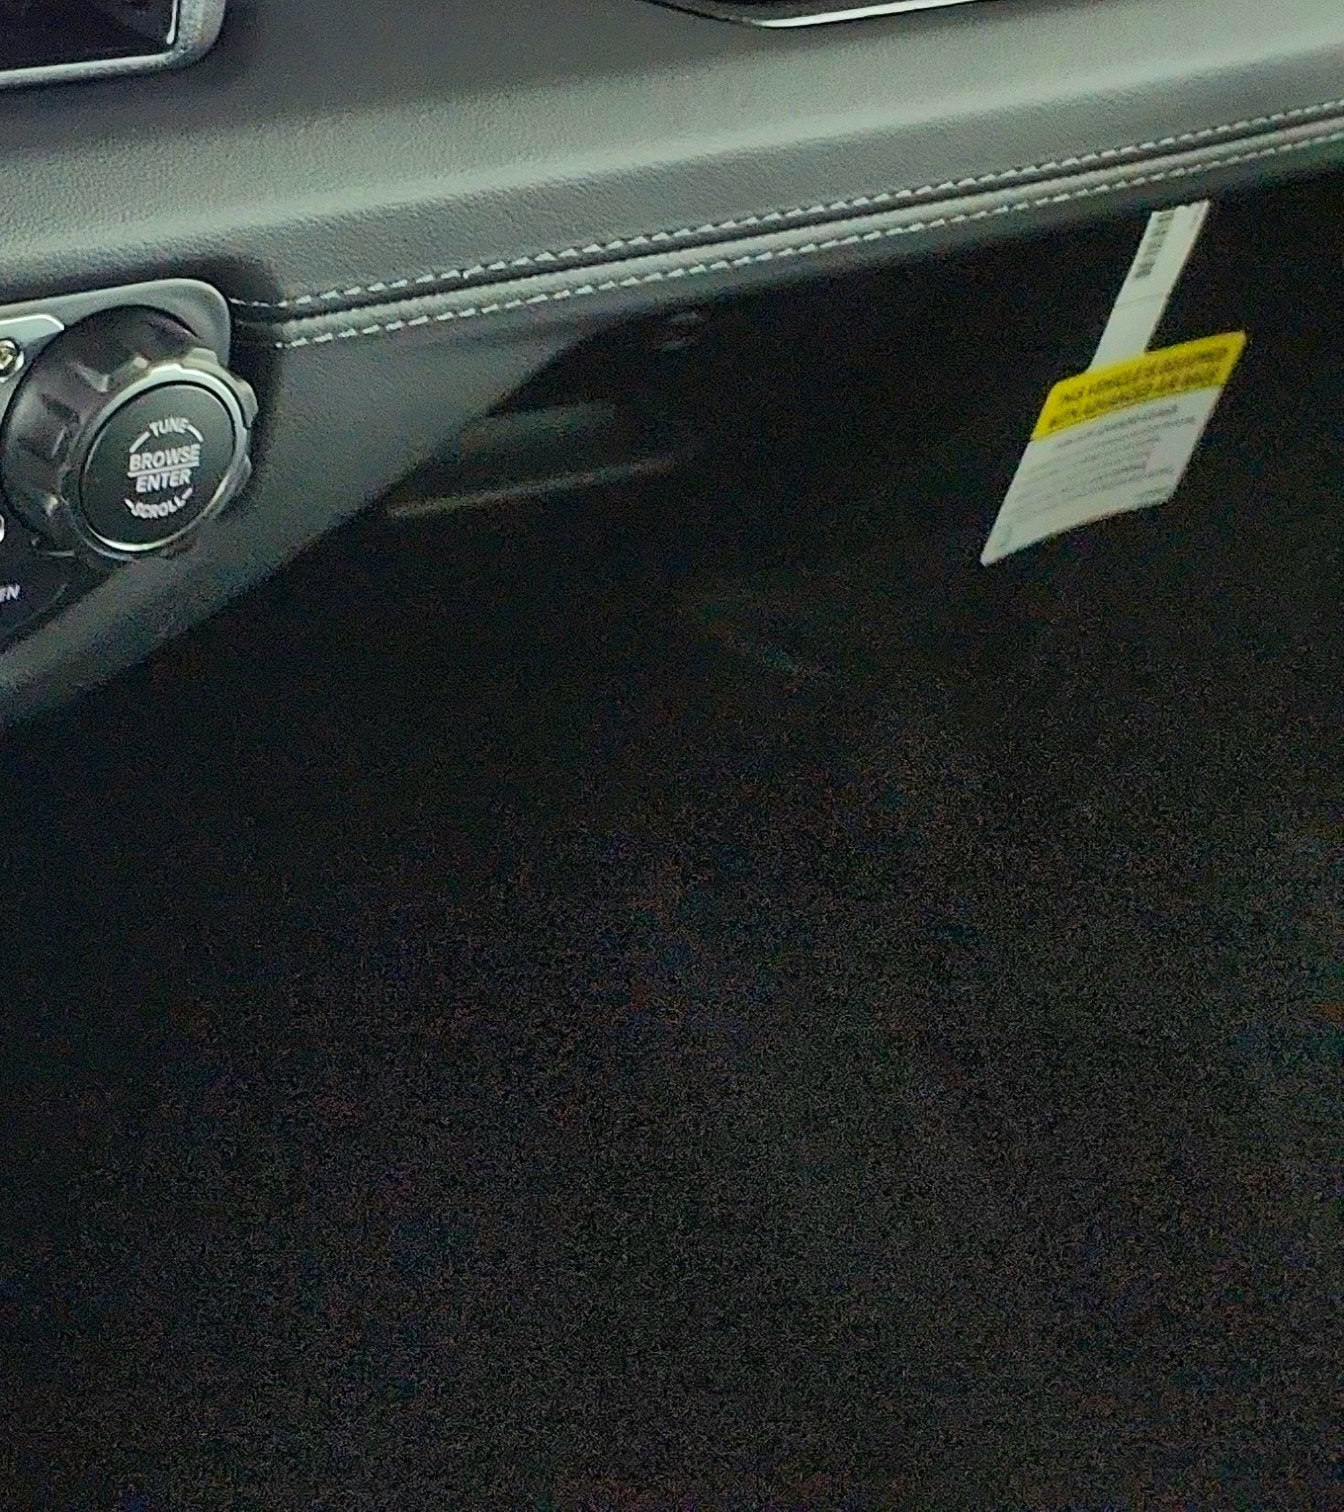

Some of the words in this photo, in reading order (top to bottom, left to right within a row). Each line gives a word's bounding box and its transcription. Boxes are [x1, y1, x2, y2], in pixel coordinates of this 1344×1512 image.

[149, 415, 189, 437] TUNE
[129, 443, 201, 472] BROWSE
[135, 468, 192, 493] ENTER
